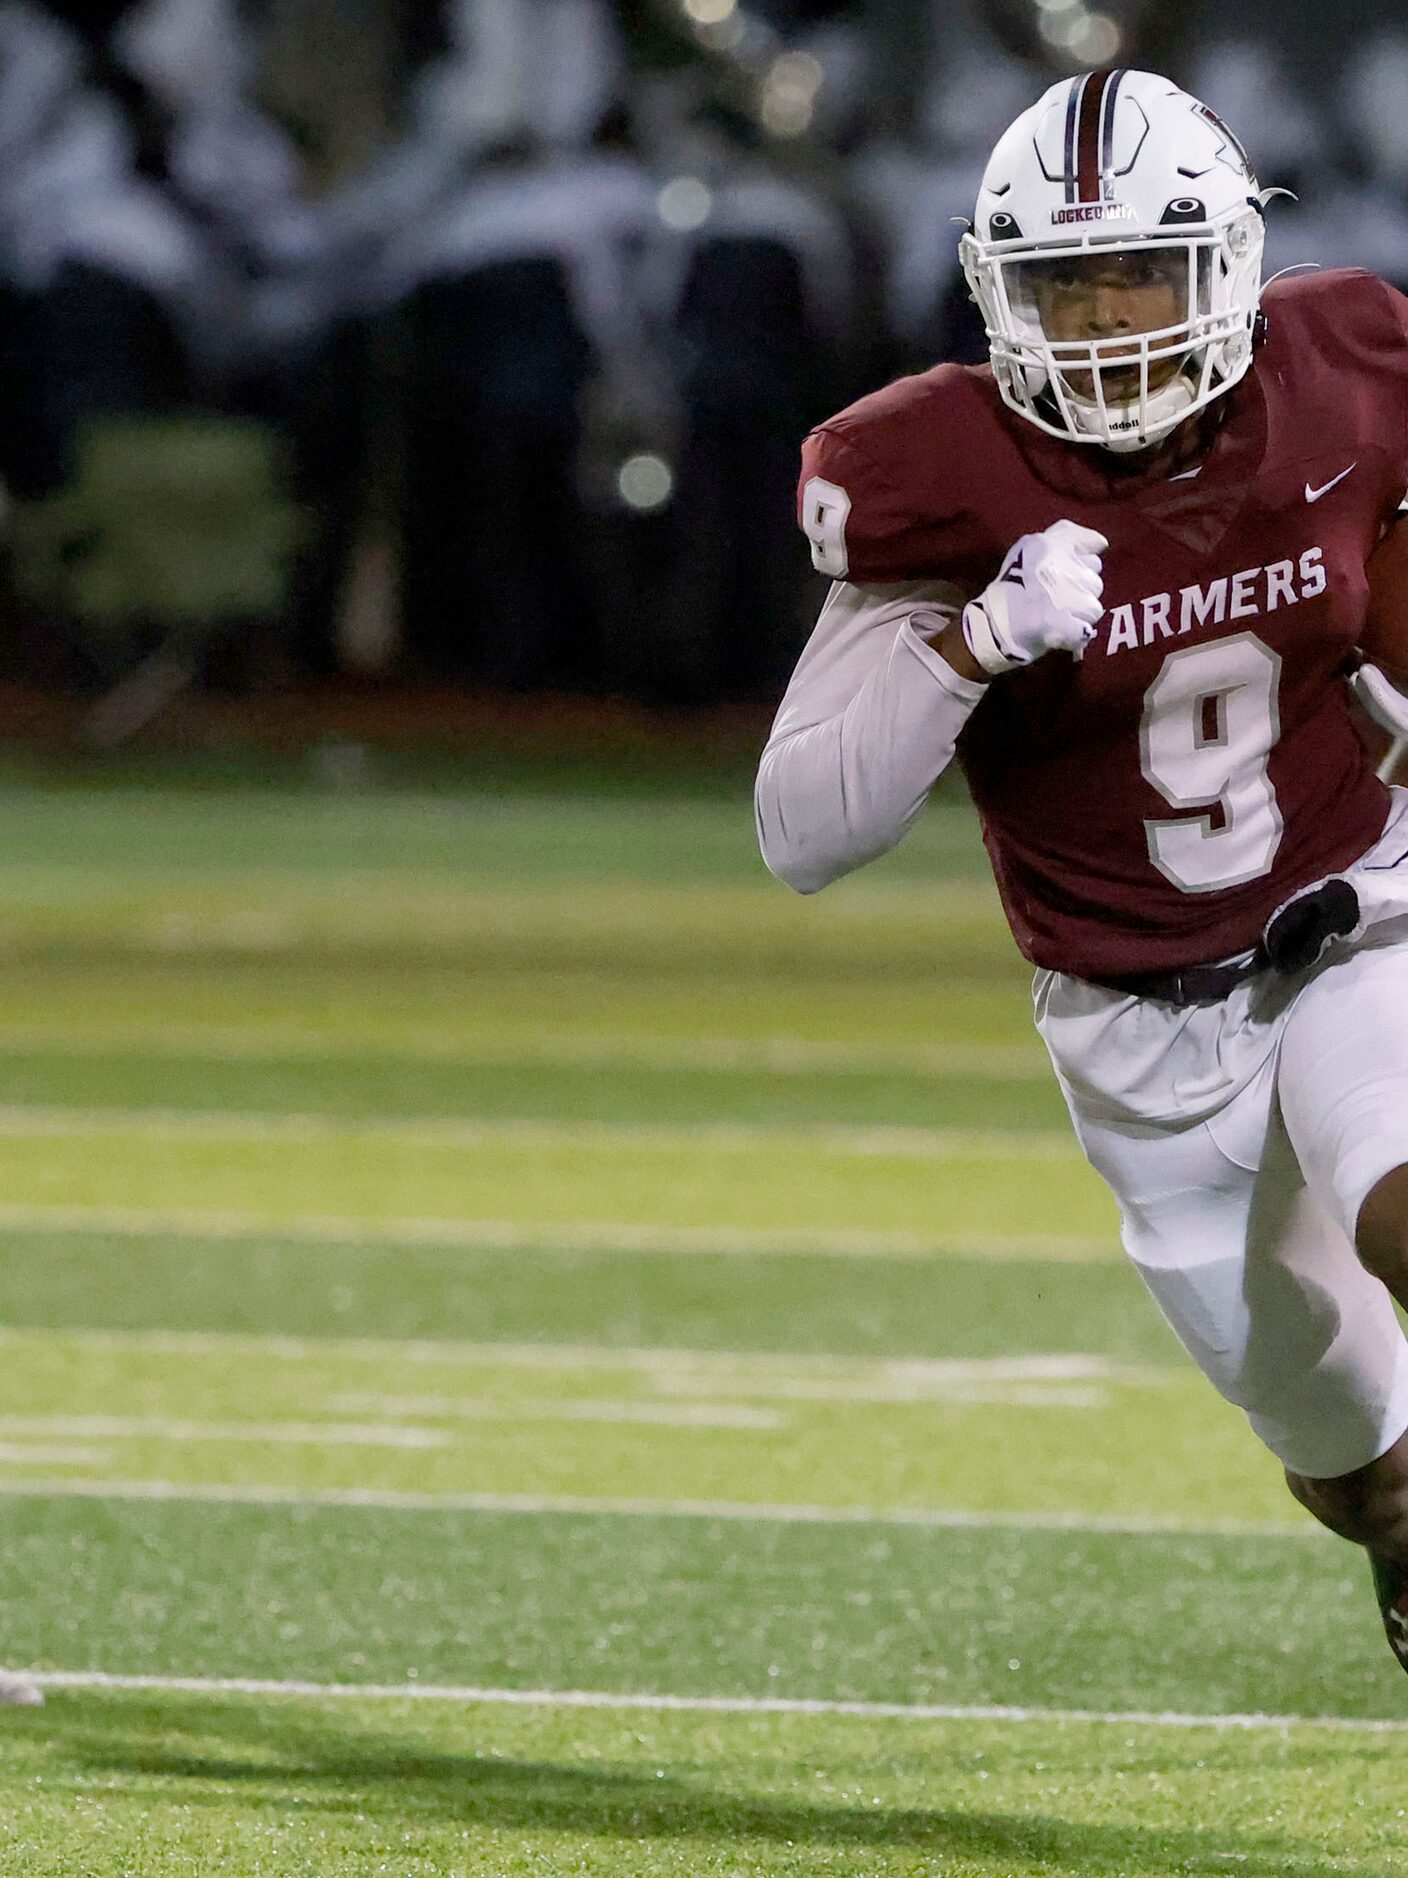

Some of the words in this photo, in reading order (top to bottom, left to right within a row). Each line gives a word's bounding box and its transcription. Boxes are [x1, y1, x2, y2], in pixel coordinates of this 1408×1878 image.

[1051, 205, 1103, 225] LOCKED
[803, 475, 852, 579] 9
[1073, 546, 1328, 663] ARMERS
[1139, 630, 1284, 894] 9
